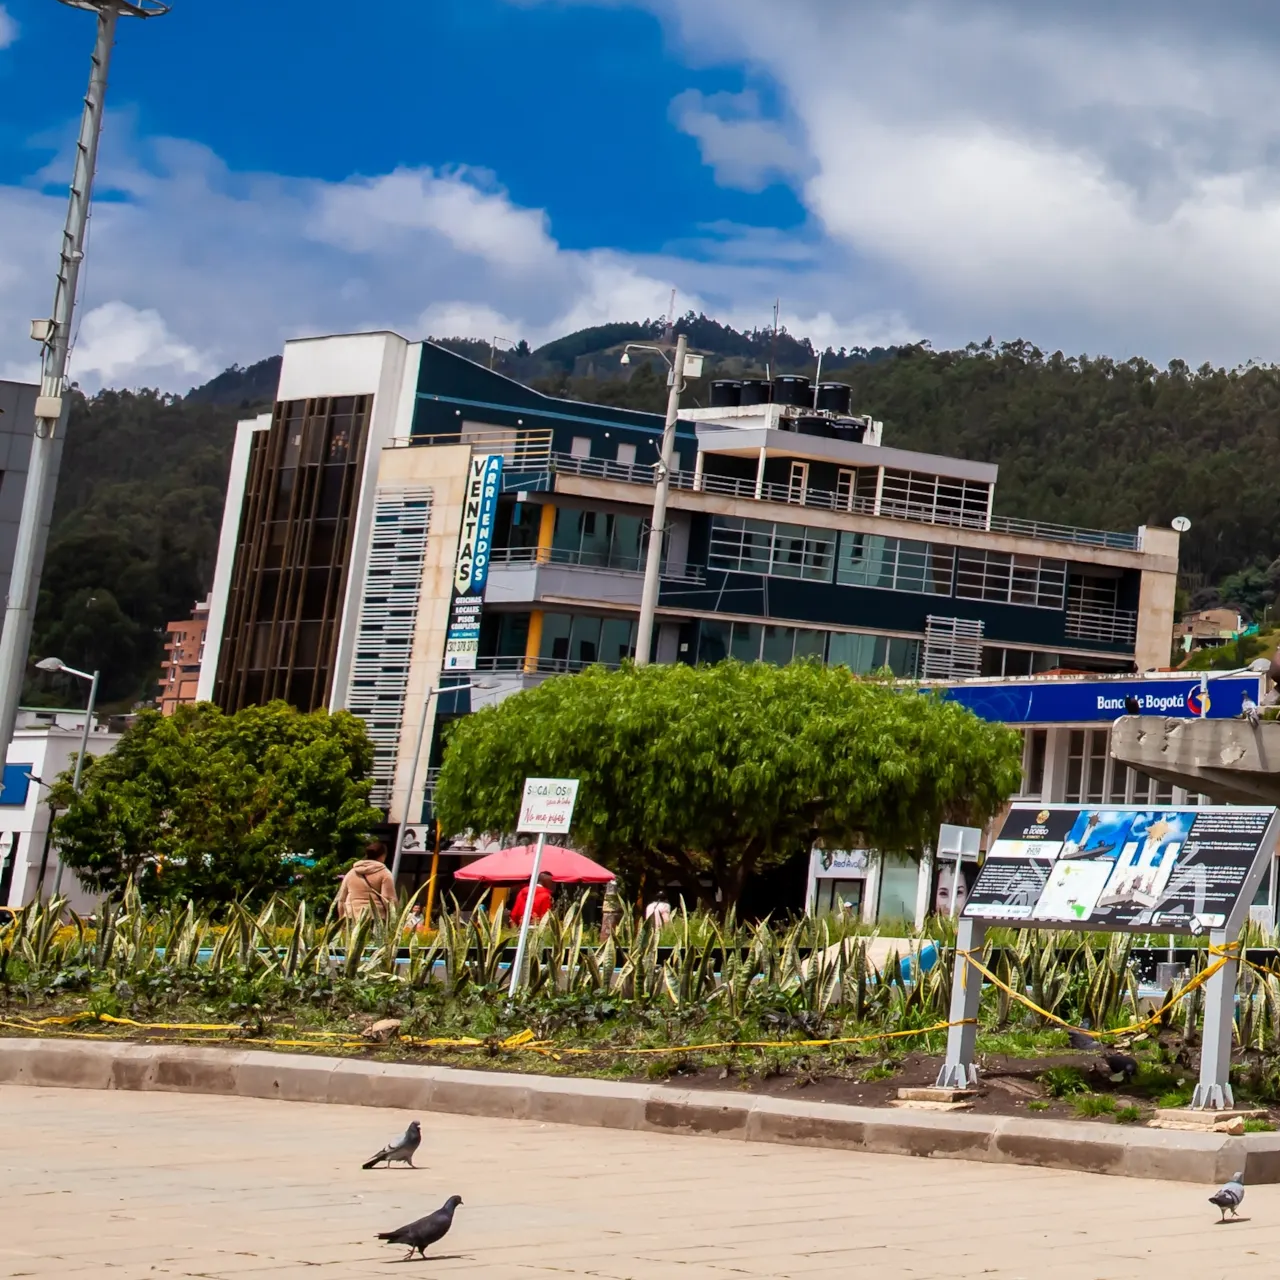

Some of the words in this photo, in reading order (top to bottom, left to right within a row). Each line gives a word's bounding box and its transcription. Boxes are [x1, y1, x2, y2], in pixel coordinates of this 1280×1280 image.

[459, 460, 486, 581] VENTAS
[475, 459, 499, 581] ARRIENDOS
[1145, 694, 1184, 711] Bogotá
